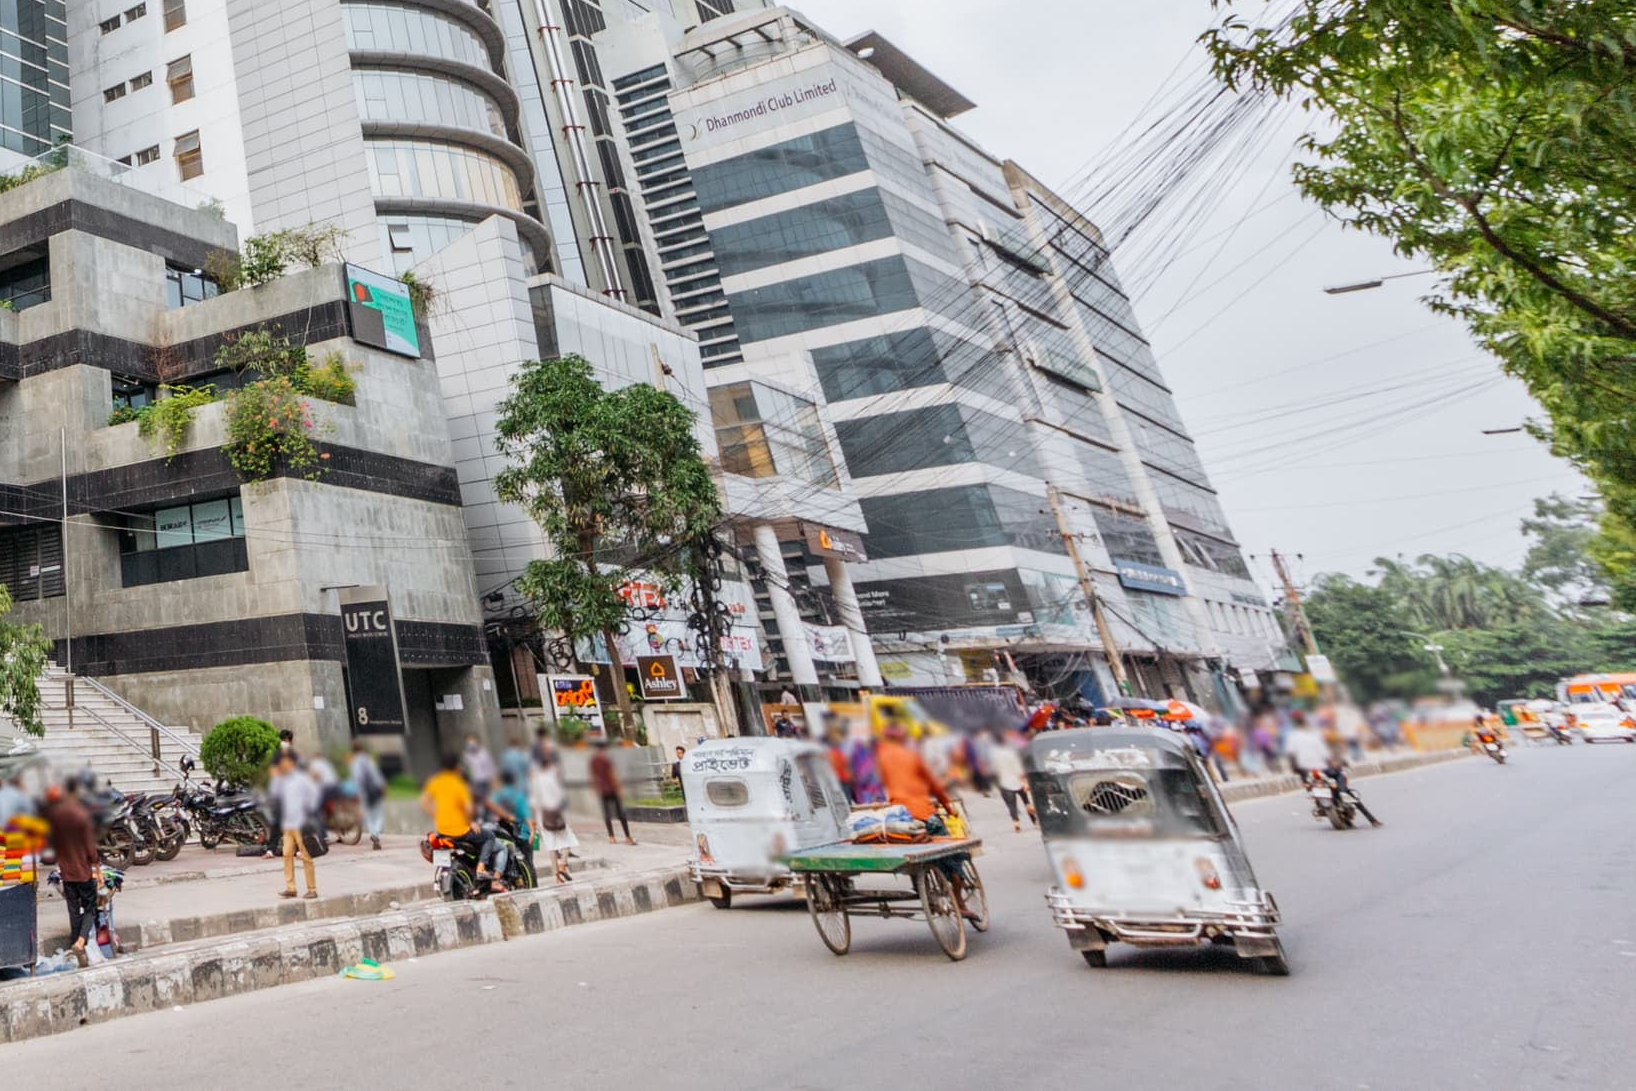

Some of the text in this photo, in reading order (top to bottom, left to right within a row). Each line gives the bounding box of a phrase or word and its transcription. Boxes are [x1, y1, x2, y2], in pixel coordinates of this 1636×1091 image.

[705, 78, 837, 131] Dhanmondi Club Limited
[345, 610, 387, 632] UTC
[644, 676, 678, 691] Ashley
[357, 706, 369, 725] 8
[691, 756, 753, 774] প্রাইভেট
